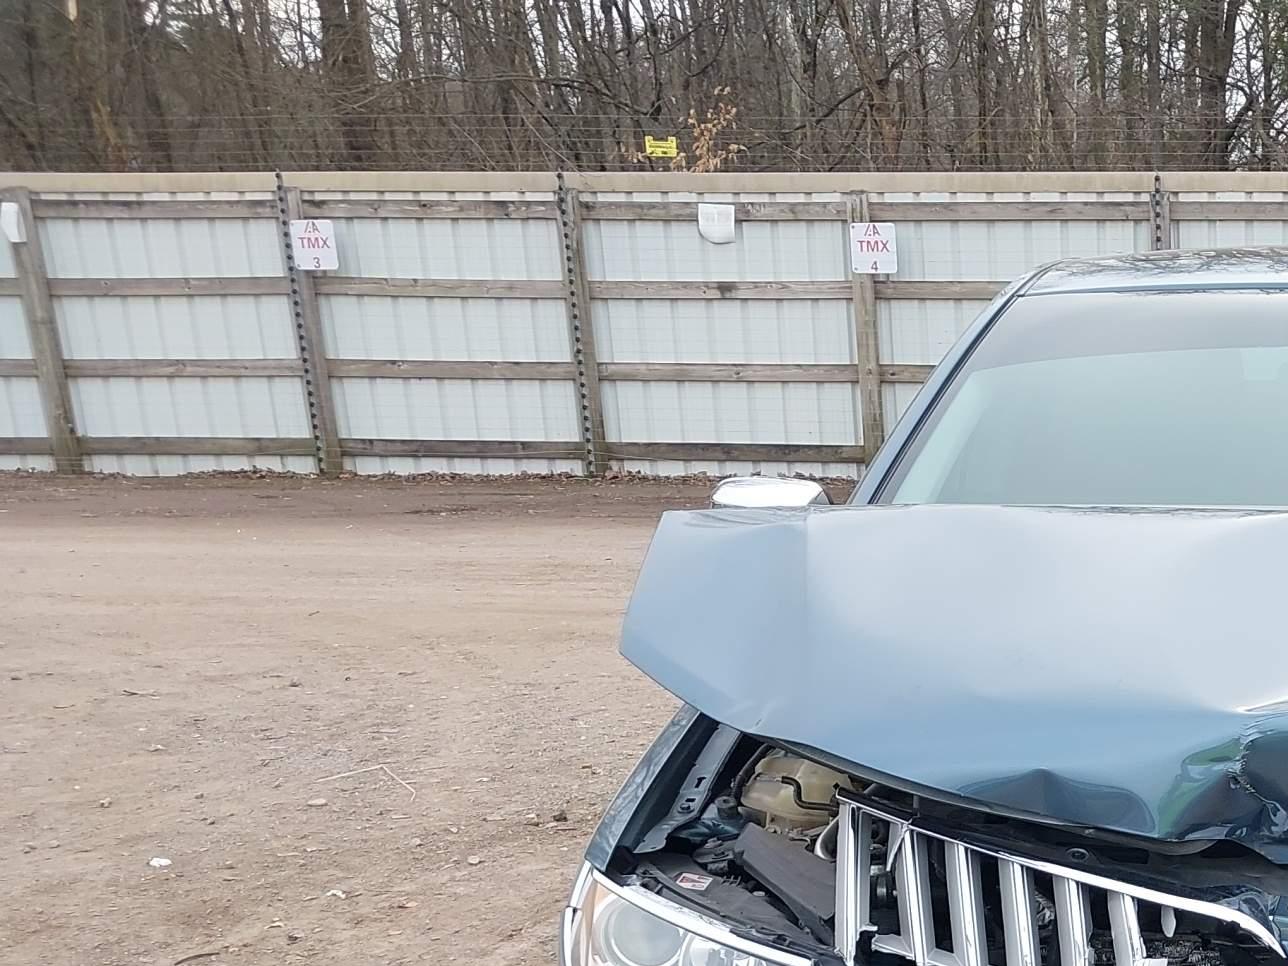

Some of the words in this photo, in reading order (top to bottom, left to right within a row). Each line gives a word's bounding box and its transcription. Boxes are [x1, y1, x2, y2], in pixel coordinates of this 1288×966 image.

[297, 236, 330, 249] TMX
[856, 240, 890, 253] TMX
[312, 256, 321, 269] 3
[870, 260, 879, 272] 4
